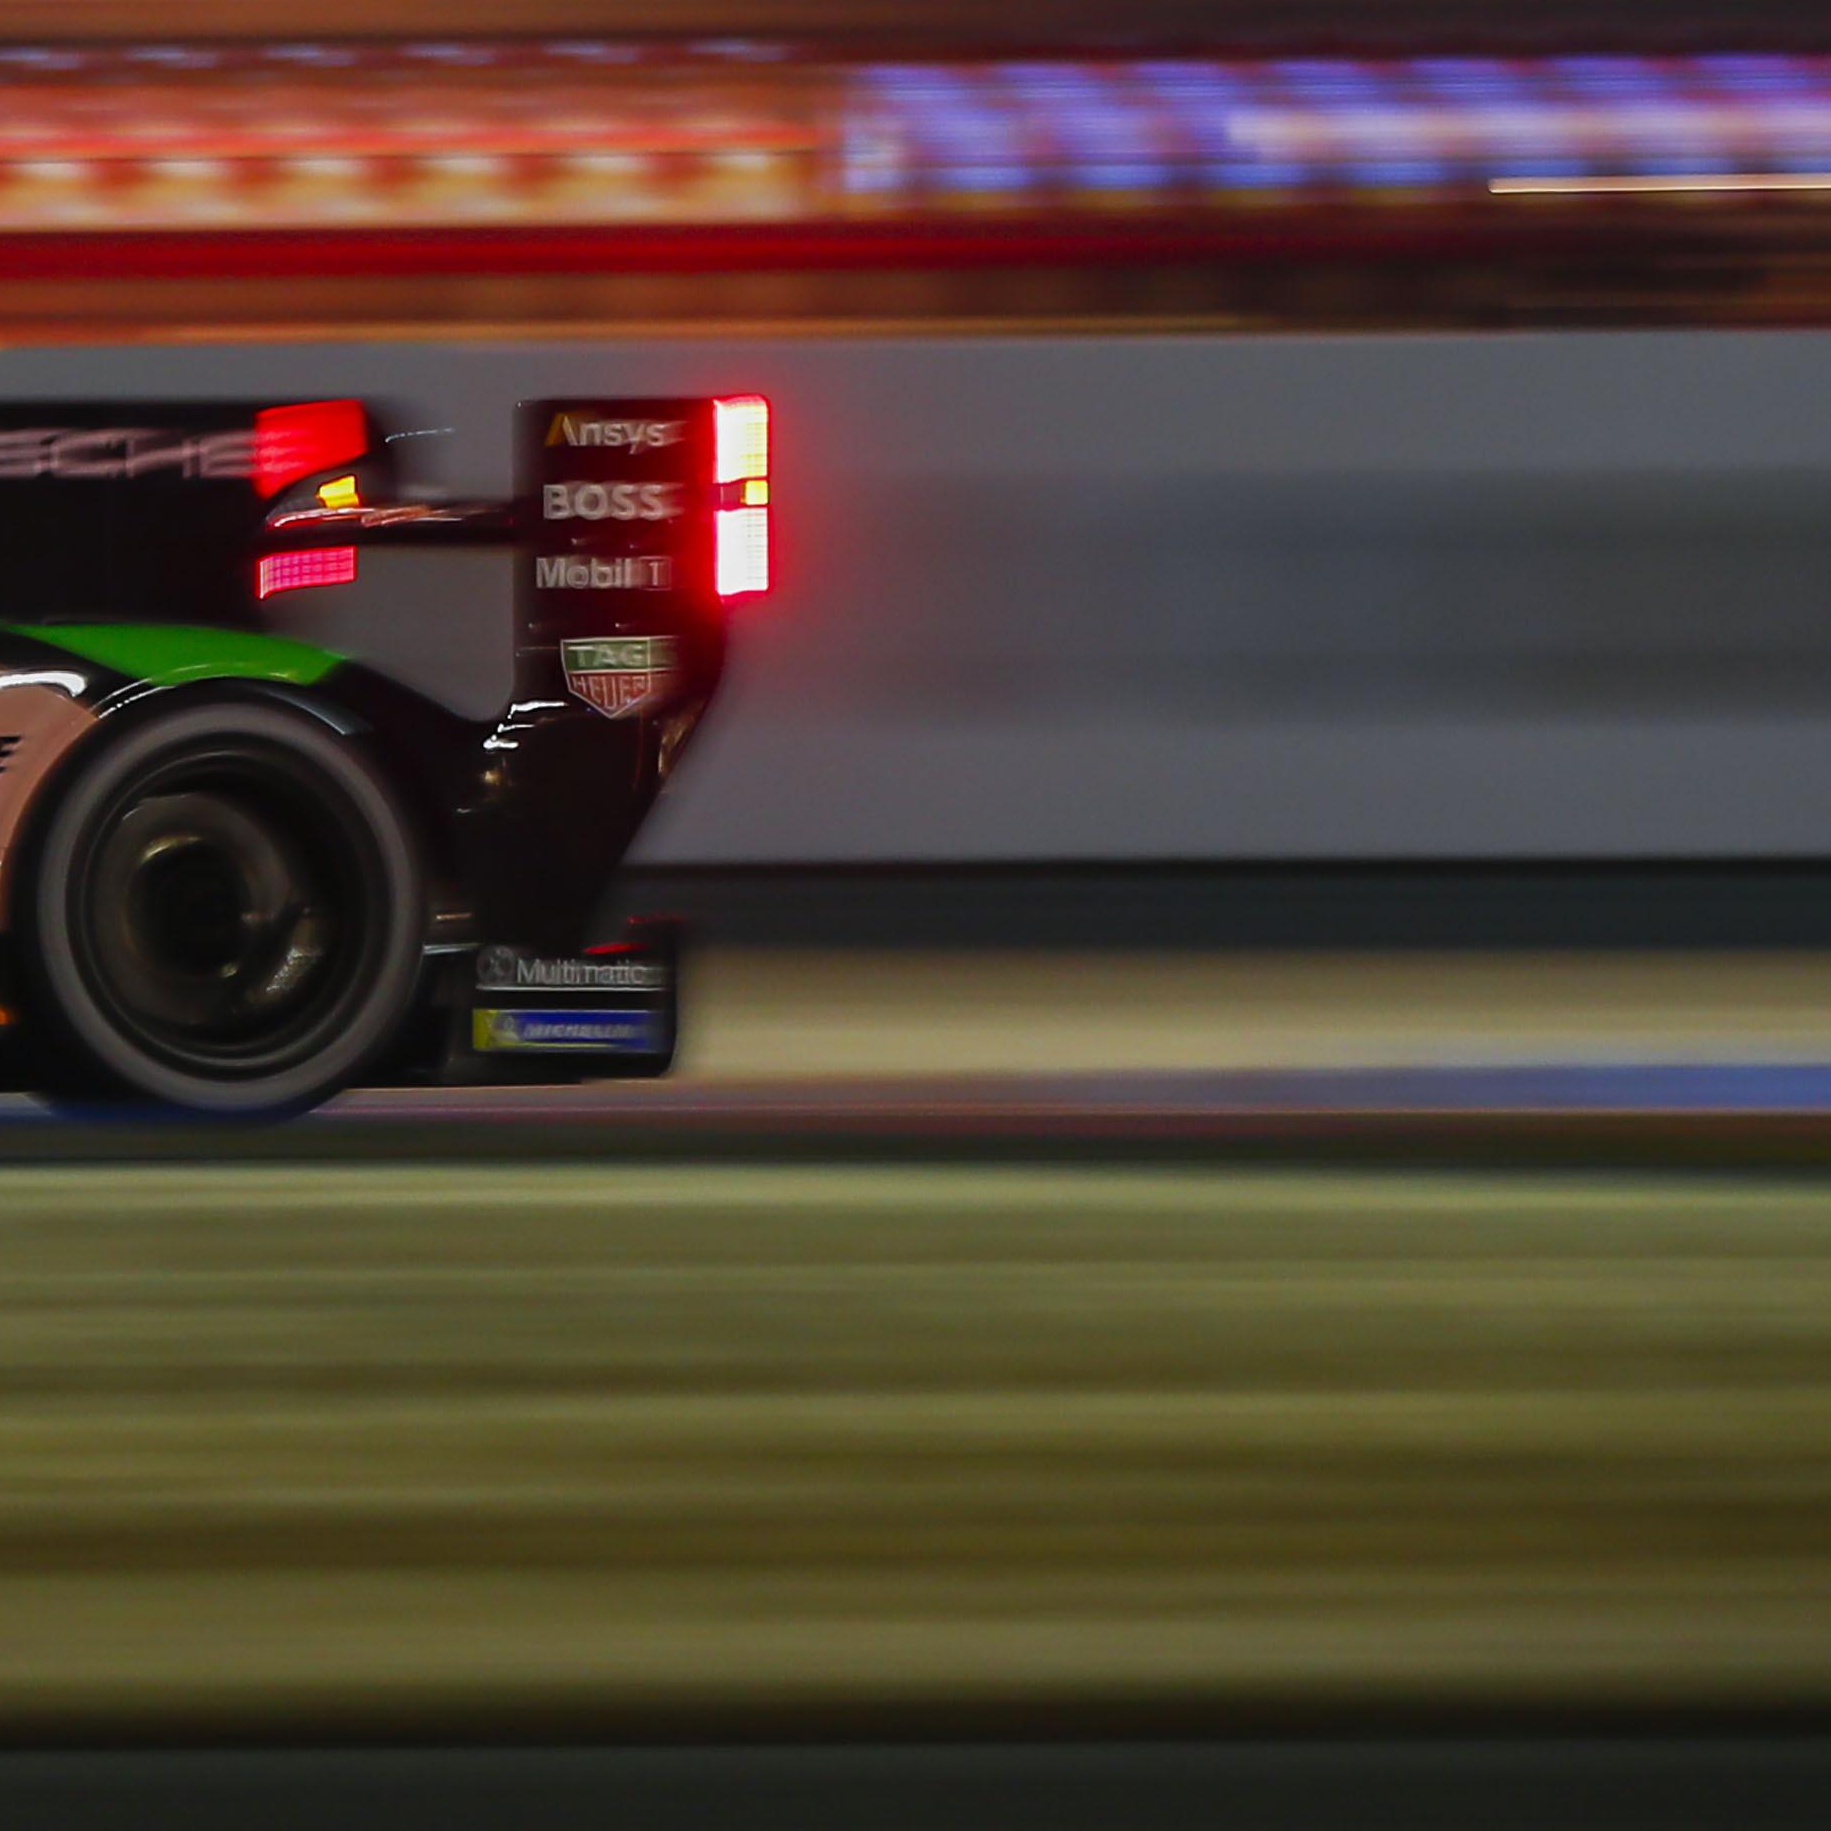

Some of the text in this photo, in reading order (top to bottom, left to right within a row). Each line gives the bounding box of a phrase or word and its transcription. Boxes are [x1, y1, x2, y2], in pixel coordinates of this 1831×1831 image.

[545, 413, 670, 454] Ansys
[543, 482, 667, 520] BOSS
[536, 556, 632, 588] Mobil
[568, 644, 646, 668] TAG
[572, 674, 651, 709] HEUER
[516, 958, 646, 984] Multimatic
